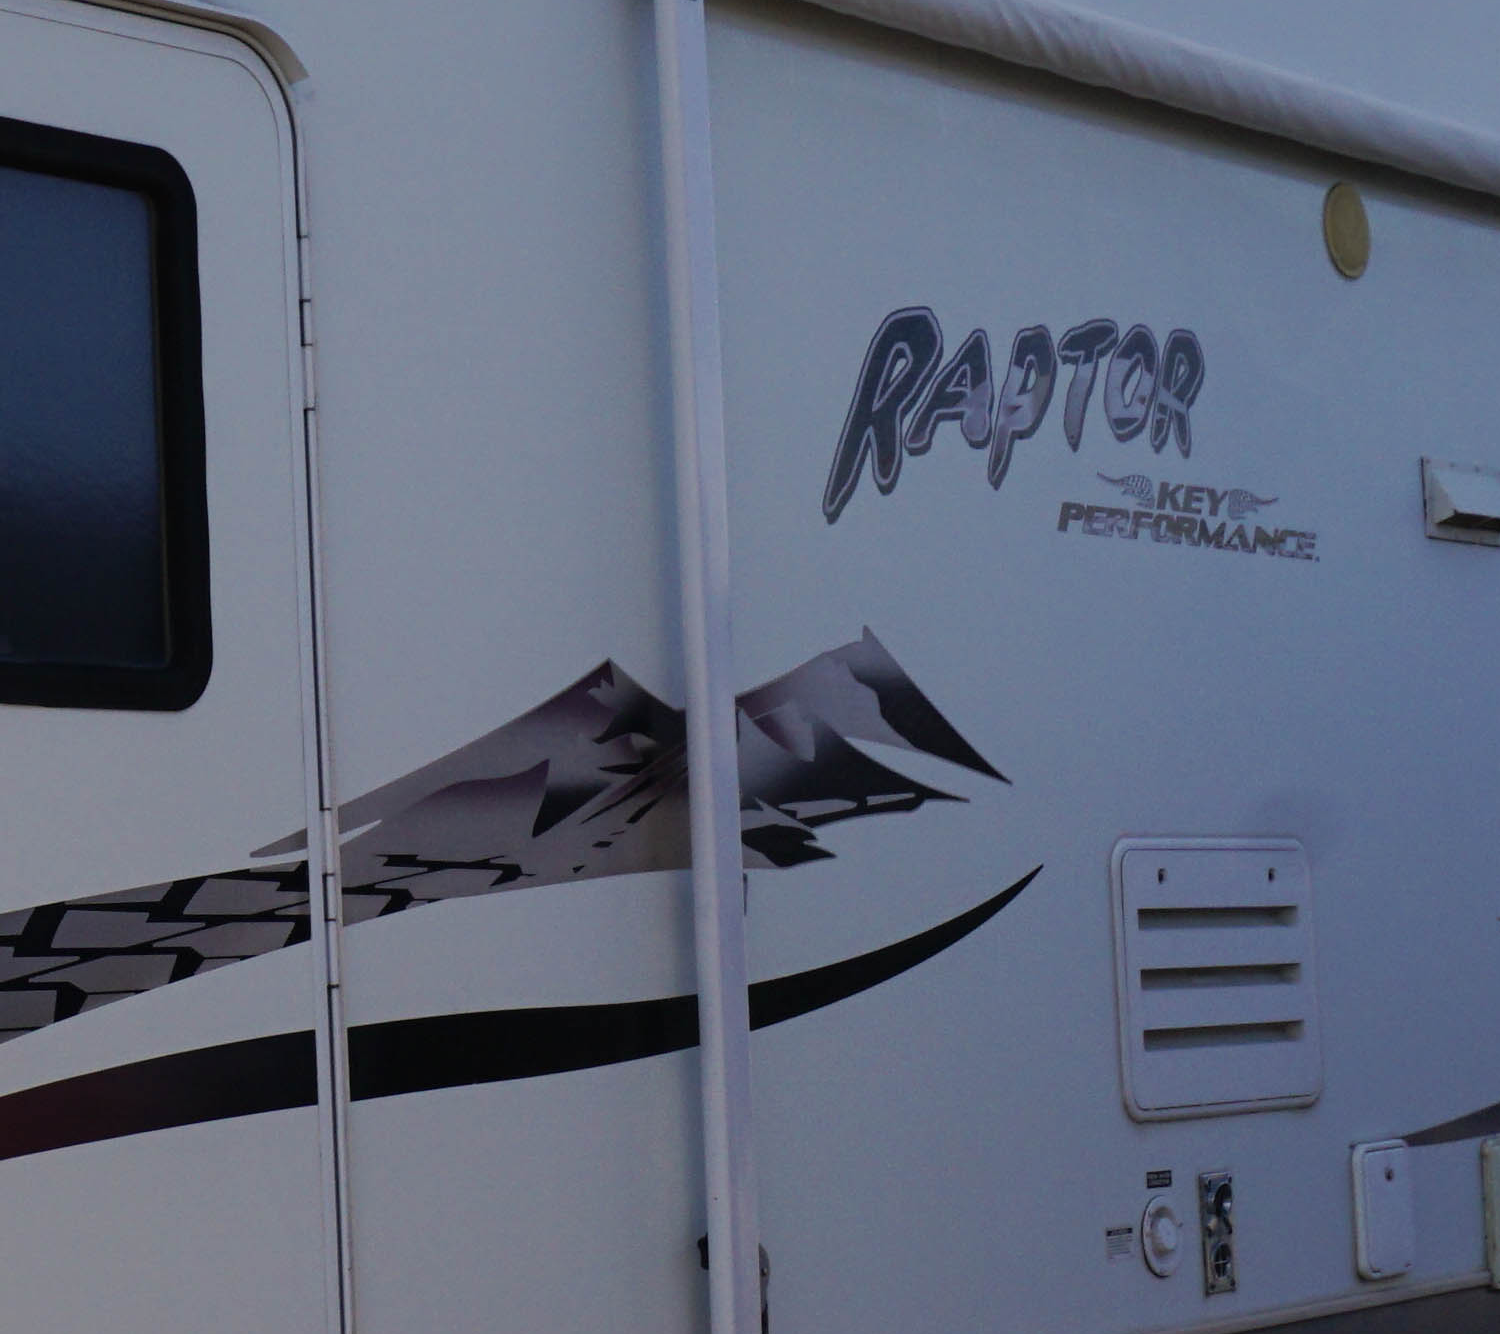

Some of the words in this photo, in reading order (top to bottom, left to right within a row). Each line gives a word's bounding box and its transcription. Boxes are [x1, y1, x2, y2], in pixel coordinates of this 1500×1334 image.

[822, 305, 1205, 525] RAPTOR
[1156, 481, 1229, 518] KEY
[1057, 501, 1318, 562] PERFORMANCE
